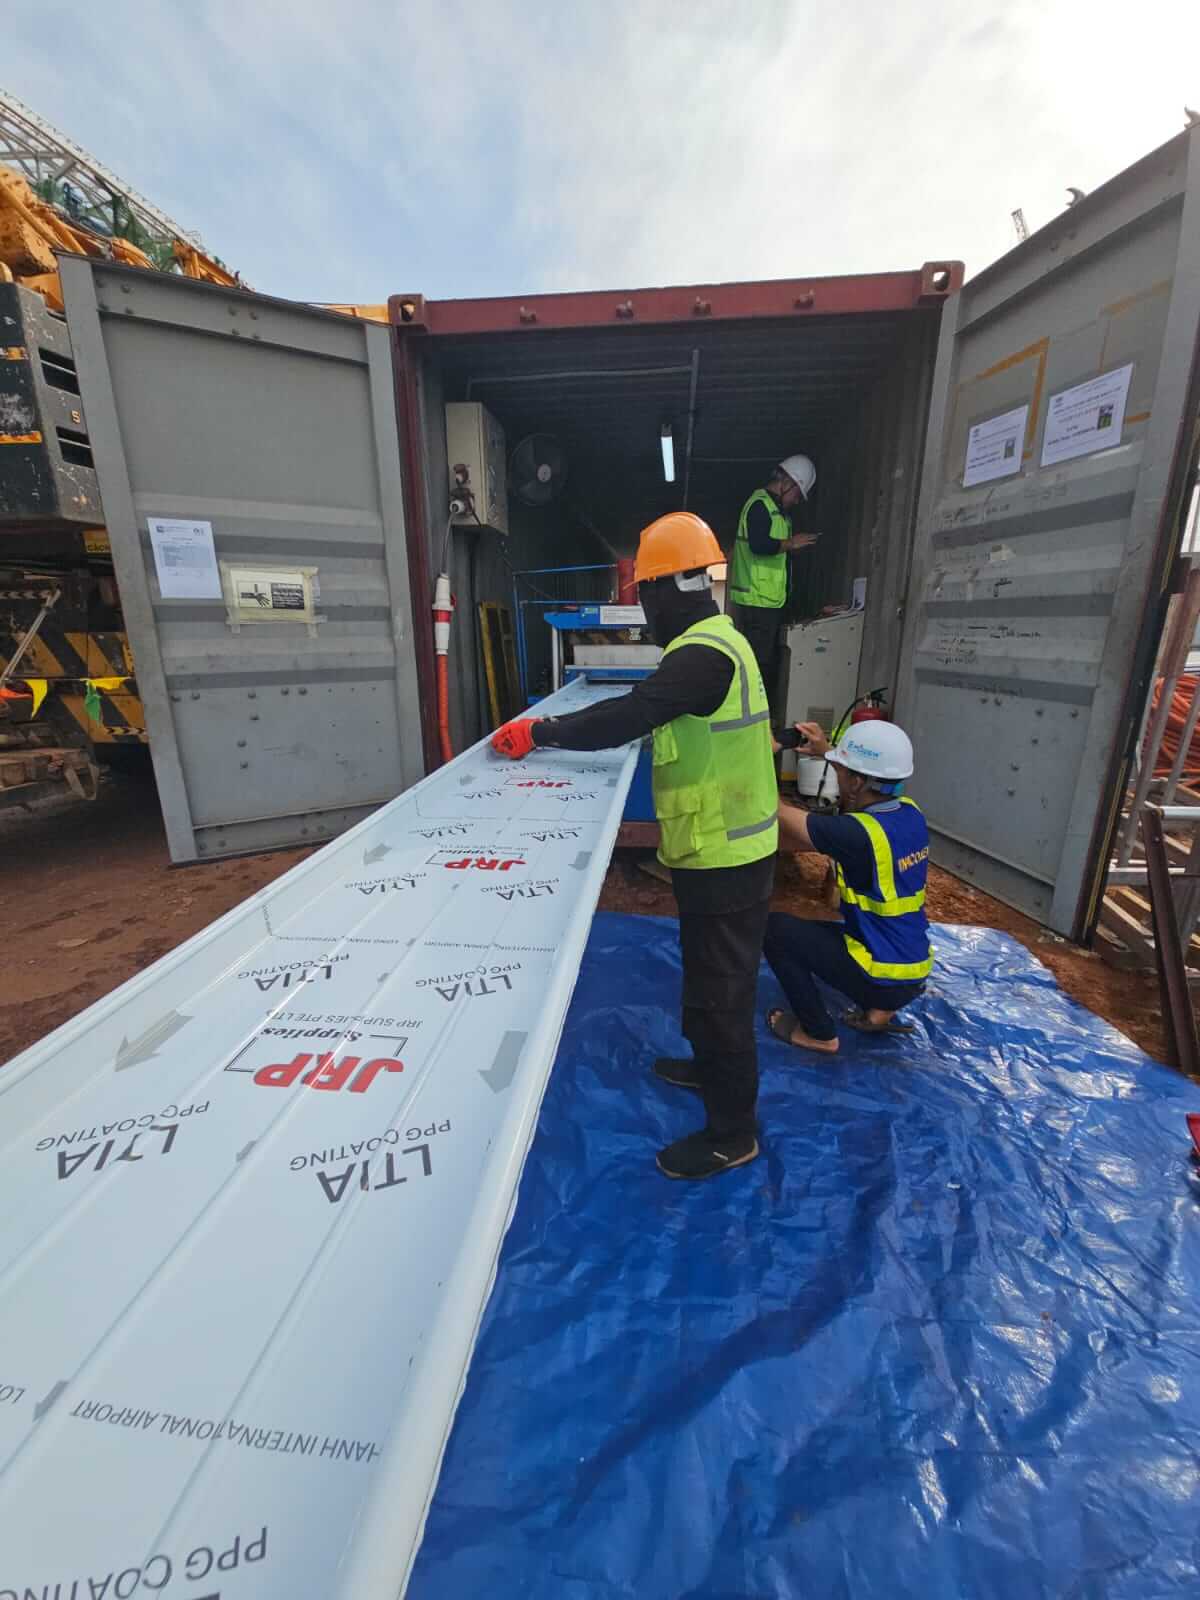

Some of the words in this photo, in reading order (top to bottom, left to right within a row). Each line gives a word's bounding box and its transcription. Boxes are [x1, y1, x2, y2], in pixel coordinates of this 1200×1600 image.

[444, 857, 526, 871] JRP
[359, 877, 416, 895] LTIA
[496, 884, 554, 900] LTIA
[238, 960, 320, 979] COATING
[254, 964, 332, 991] LTIA
[415, 965, 487, 987] COATING
[490, 962, 522, 974] PPG
[435, 974, 512, 1001] LTIA
[297, 1013, 321, 1022] PTE
[396, 1019, 423, 1029] JRP
[261, 1027, 363, 1042] Supplies
[253, 1050, 405, 1093] JRP
[159, 1100, 211, 1118] PPG
[34, 1114, 156, 1151] COATING
[405, 1119, 452, 1141] PPG
[57, 1123, 180, 1180] LTIA
[289, 1128, 400, 1171] COATING
[316, 1143, 433, 1204] LTIA
[70, 1399, 157, 1430] AIRPORT
[160, 1414, 319, 1452] INTERNATIONAL
[185, 1525, 269, 1581] PPG
